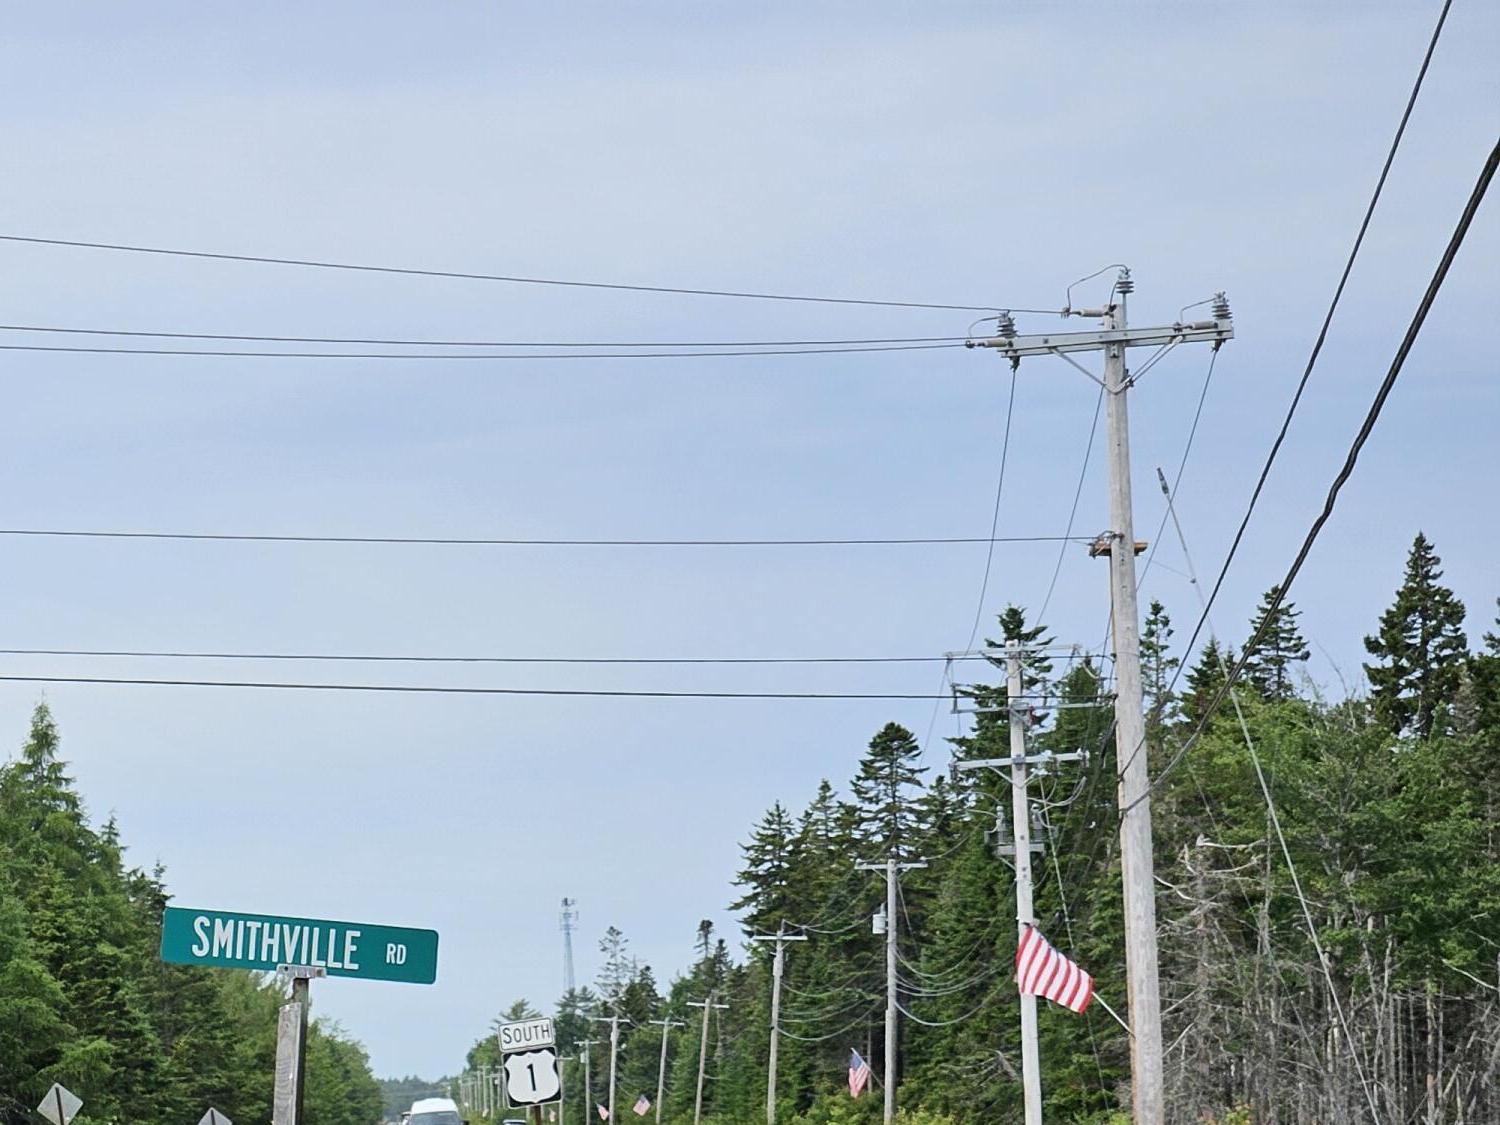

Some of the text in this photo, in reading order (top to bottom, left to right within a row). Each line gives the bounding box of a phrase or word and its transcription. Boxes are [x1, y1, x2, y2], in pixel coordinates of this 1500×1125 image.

[192, 916, 406, 970] SMITHVILLE RD
[502, 1024, 550, 1044] SOUTH
[526, 1063, 536, 1091] 1
